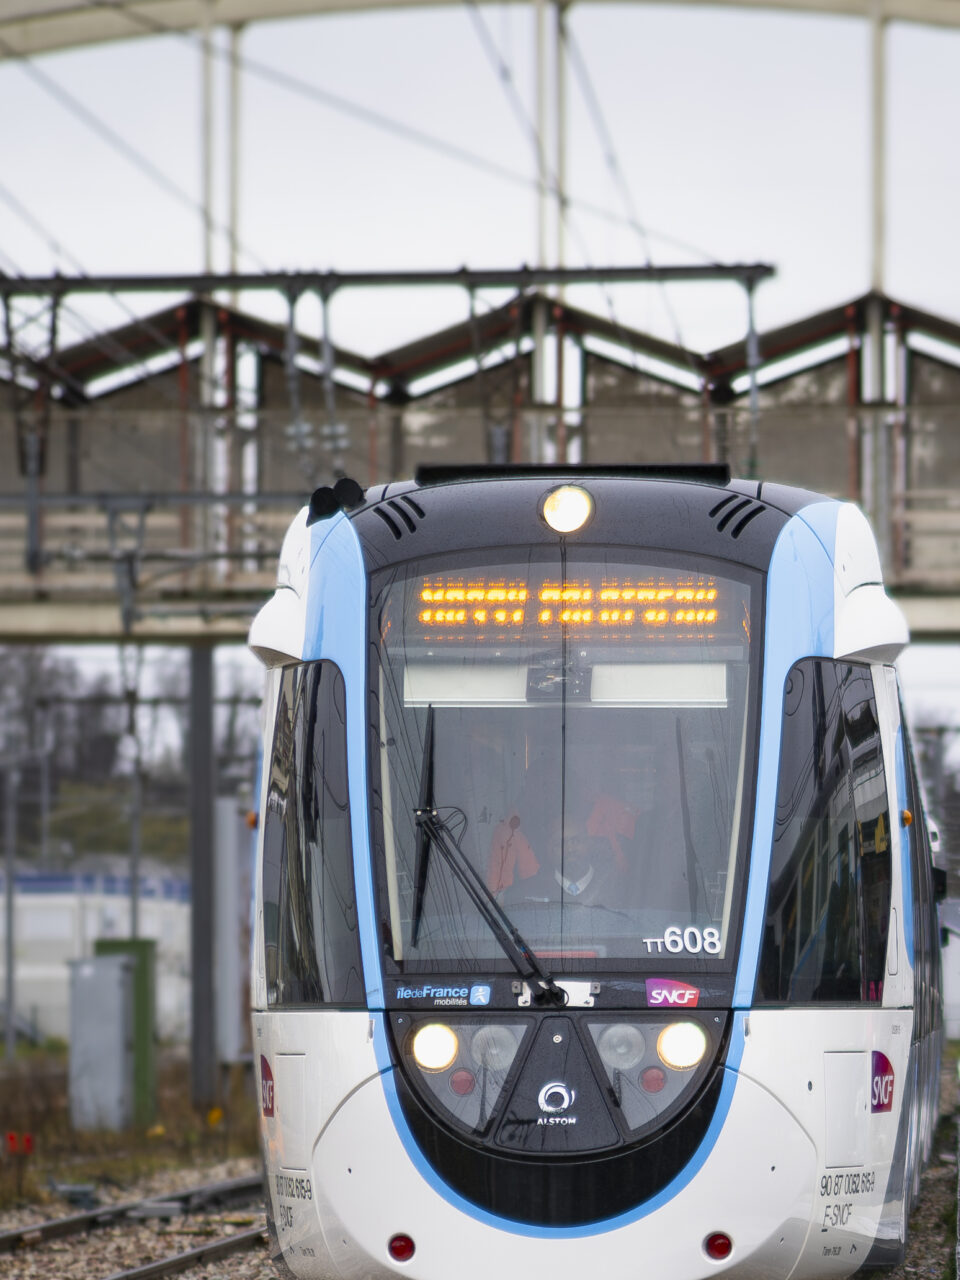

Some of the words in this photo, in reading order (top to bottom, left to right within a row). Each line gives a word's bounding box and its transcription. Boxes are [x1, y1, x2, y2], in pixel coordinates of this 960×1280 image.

[434, 997, 468, 1006] mobilités
[650, 989, 697, 1004] SNCF
[871, 1075, 894, 1106] SNCF
[537, 1117, 577, 1126] ALSTOM
[820, 1175, 833, 1197] 90
[833, 1174, 844, 1196] 87
